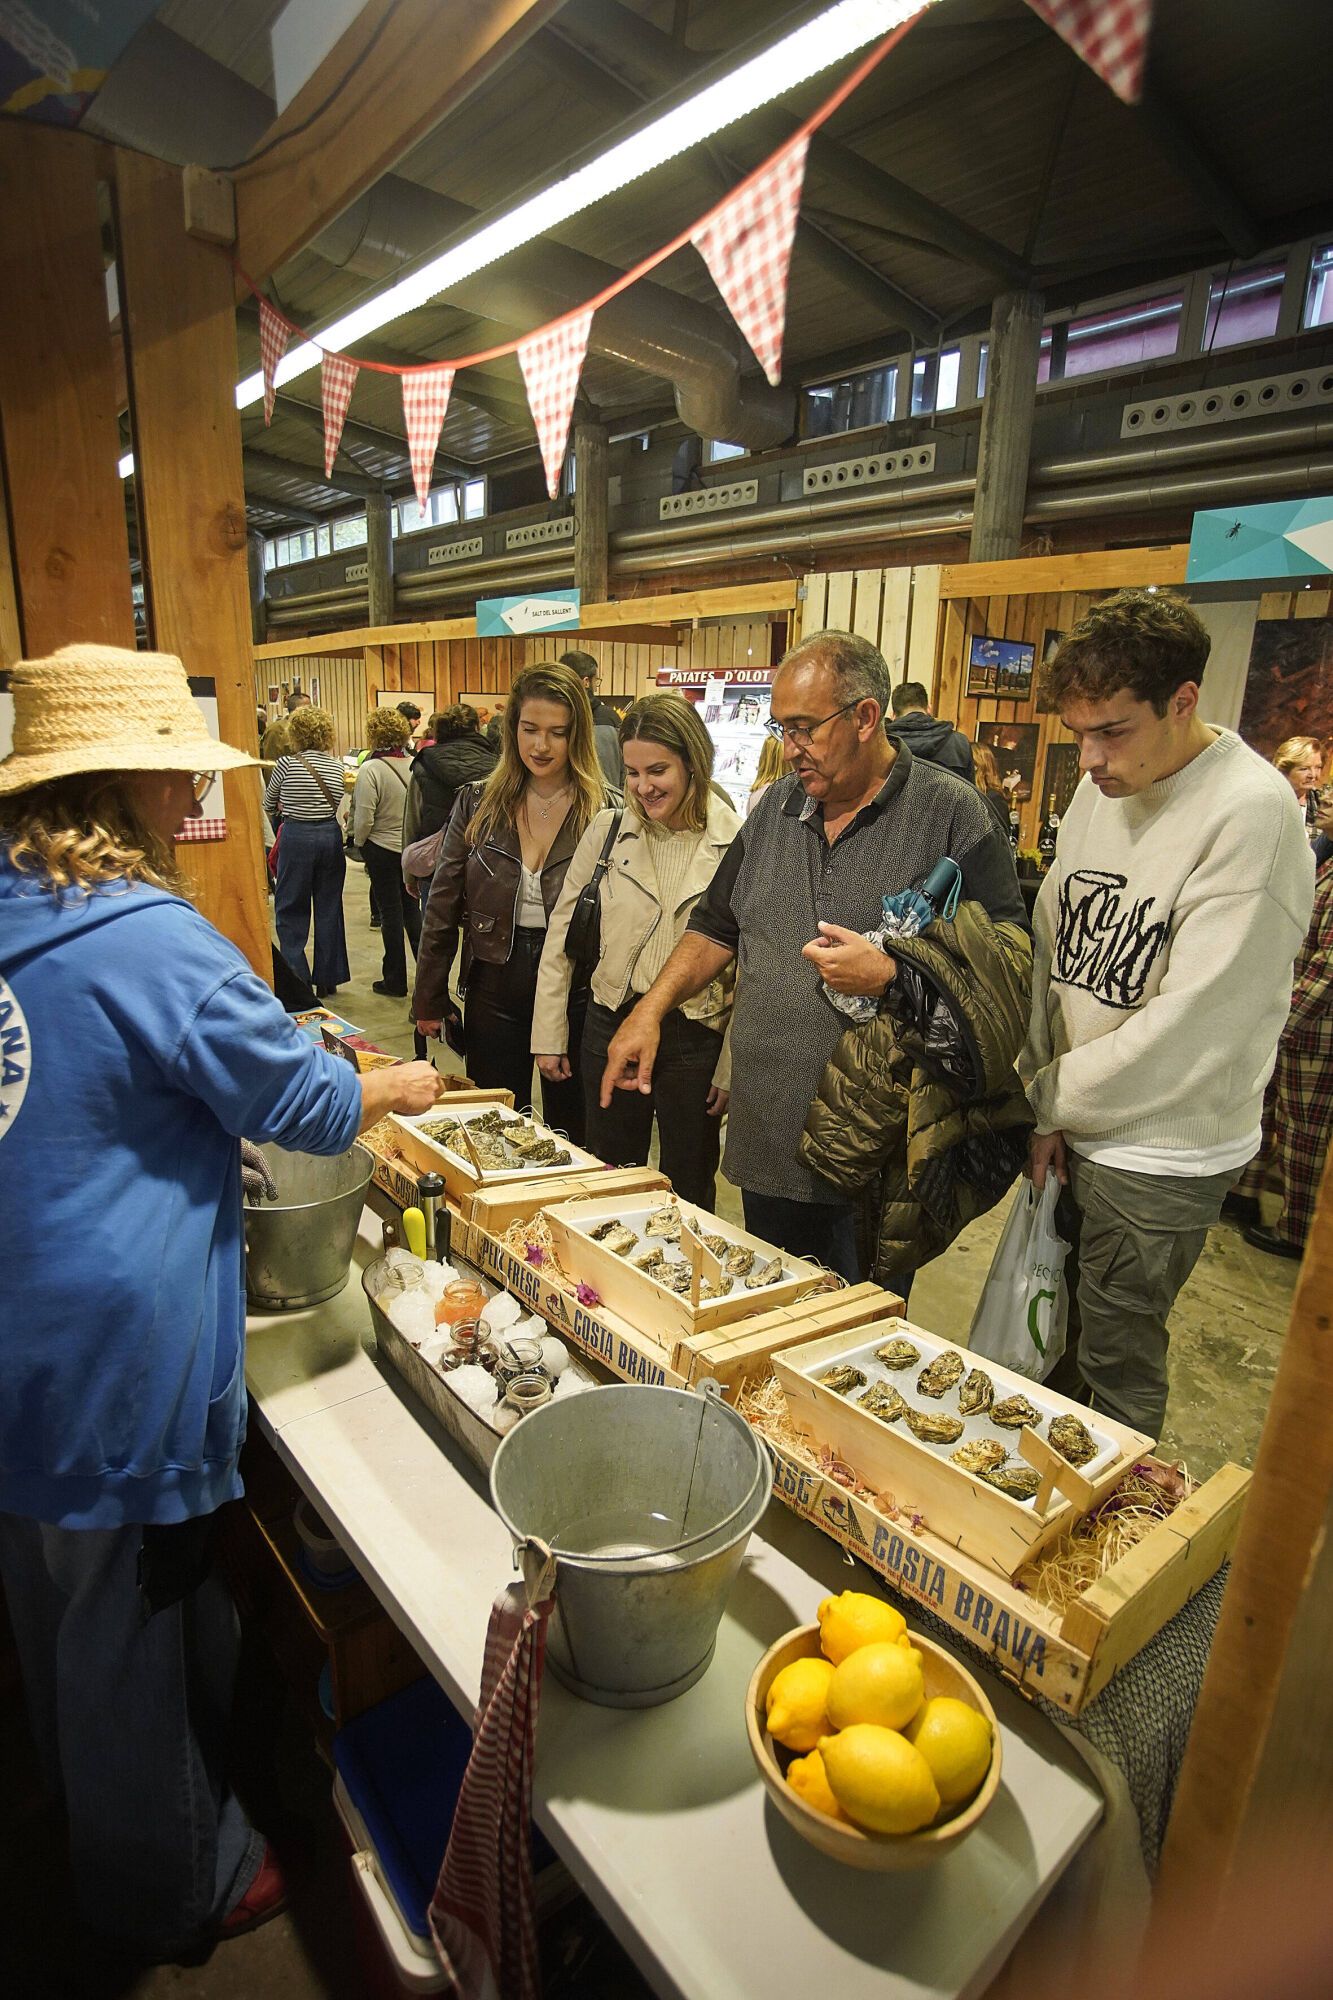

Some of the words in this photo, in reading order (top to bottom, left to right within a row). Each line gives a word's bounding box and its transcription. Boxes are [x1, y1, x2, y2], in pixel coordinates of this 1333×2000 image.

[552, 607, 572, 615] SALLENT
[669, 671, 715, 683] PATATES
[724, 669, 771, 682] D'OLOT
[0, 983, 26, 1087] ANA
[507, 1256, 541, 1303] FRESC
[573, 1308, 614, 1361] COSTA
[872, 1522, 947, 1606] COSTA
[954, 1581, 1046, 1678] BRAVA
